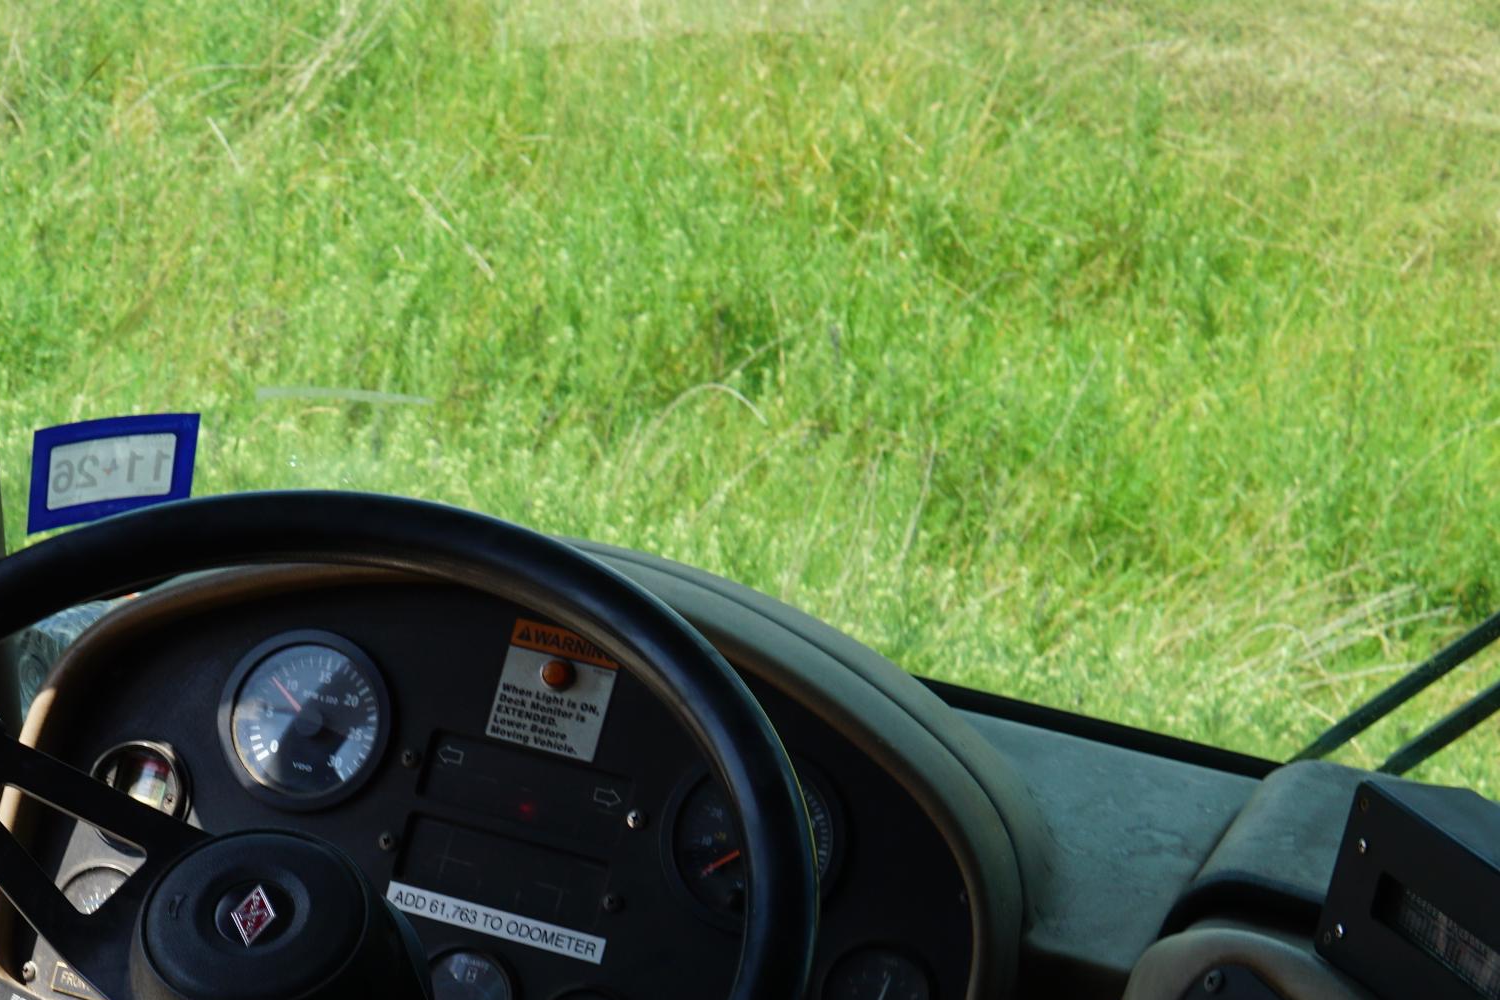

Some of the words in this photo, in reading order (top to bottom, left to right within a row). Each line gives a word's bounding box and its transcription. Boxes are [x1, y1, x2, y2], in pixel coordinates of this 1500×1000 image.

[500, 693, 526, 708] Deck
[530, 702, 572, 719] Monitor
[576, 713, 586, 723] is
[502, 683, 532, 698] When
[535, 691, 564, 706] Light
[567, 699, 577, 709] is
[491, 724, 529, 744] Moving
[494, 714, 526, 730] Lower
[531, 724, 567, 740] Before
[269, 739, 279, 754] 0
[394, 891, 426, 910] ADD
[429, 900, 478, 925] 61,763
[482, 913, 503, 931] TO
[506, 919, 597, 957] ODOMETER
